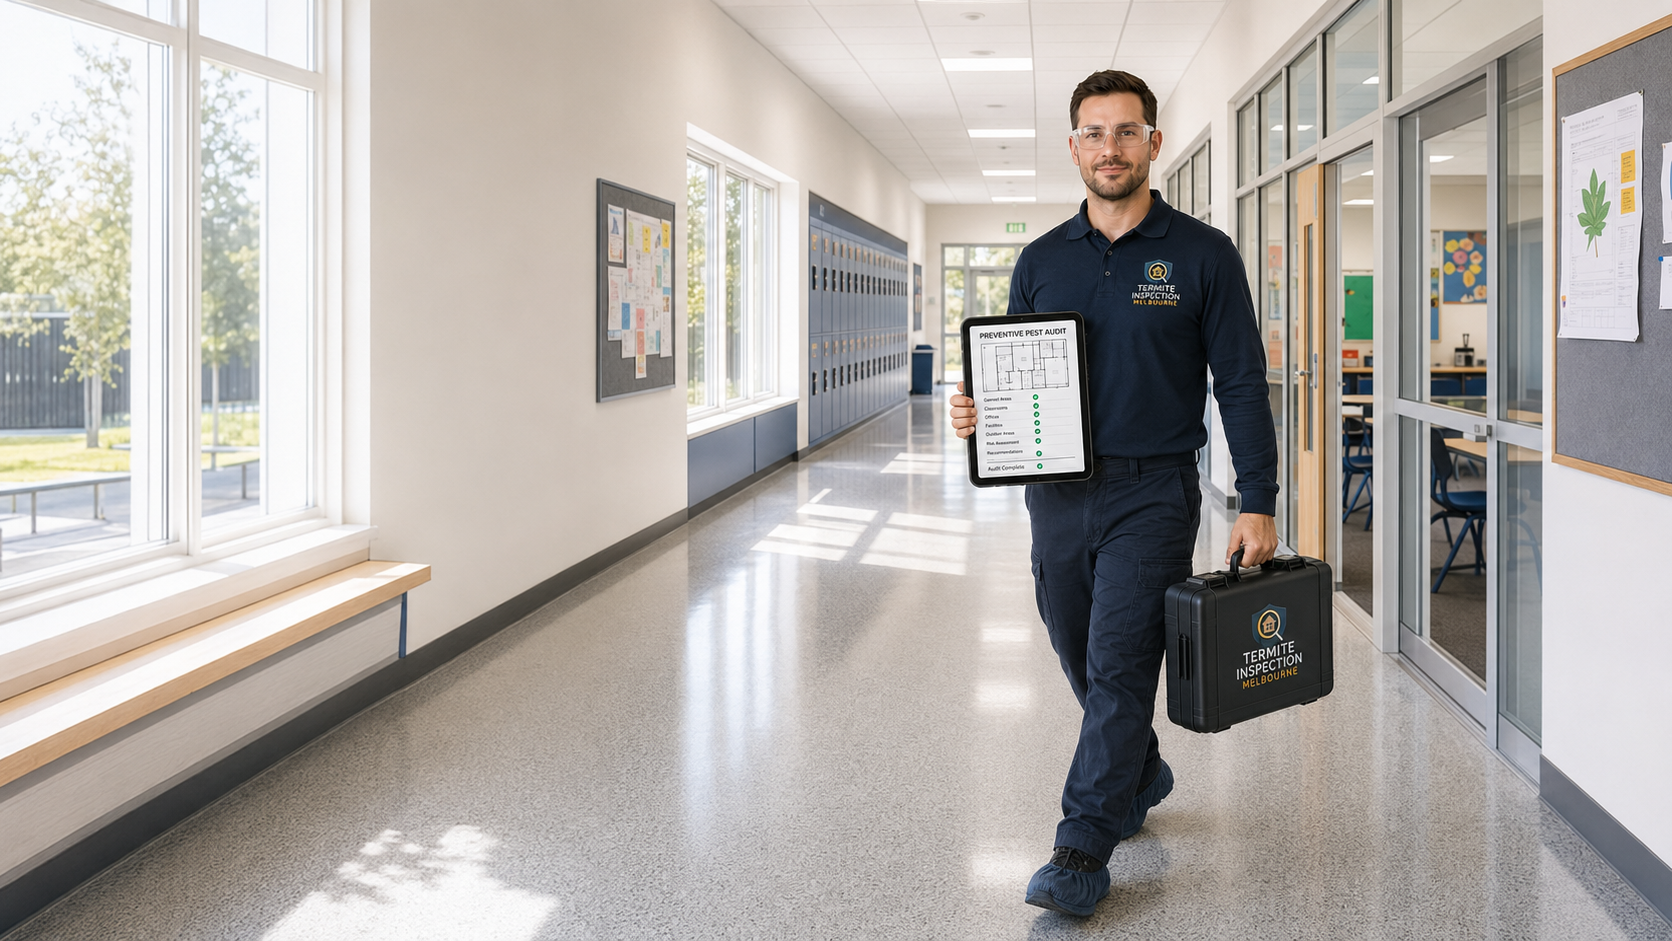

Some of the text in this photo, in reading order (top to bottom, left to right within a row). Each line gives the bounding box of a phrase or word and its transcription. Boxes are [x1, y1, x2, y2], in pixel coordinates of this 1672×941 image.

[1137, 284, 1176, 293] TERMITE
[1131, 291, 1181, 300] INSPECTION
[1132, 299, 1178, 307] MELBOURNE
[979, 327, 1067, 339] PREVENTIVE PEST AUDIT
[1242, 640, 1295, 665] TERMITE
[1236, 652, 1303, 681] INSPECTION
[1242, 666, 1298, 690] MELBOURNE
